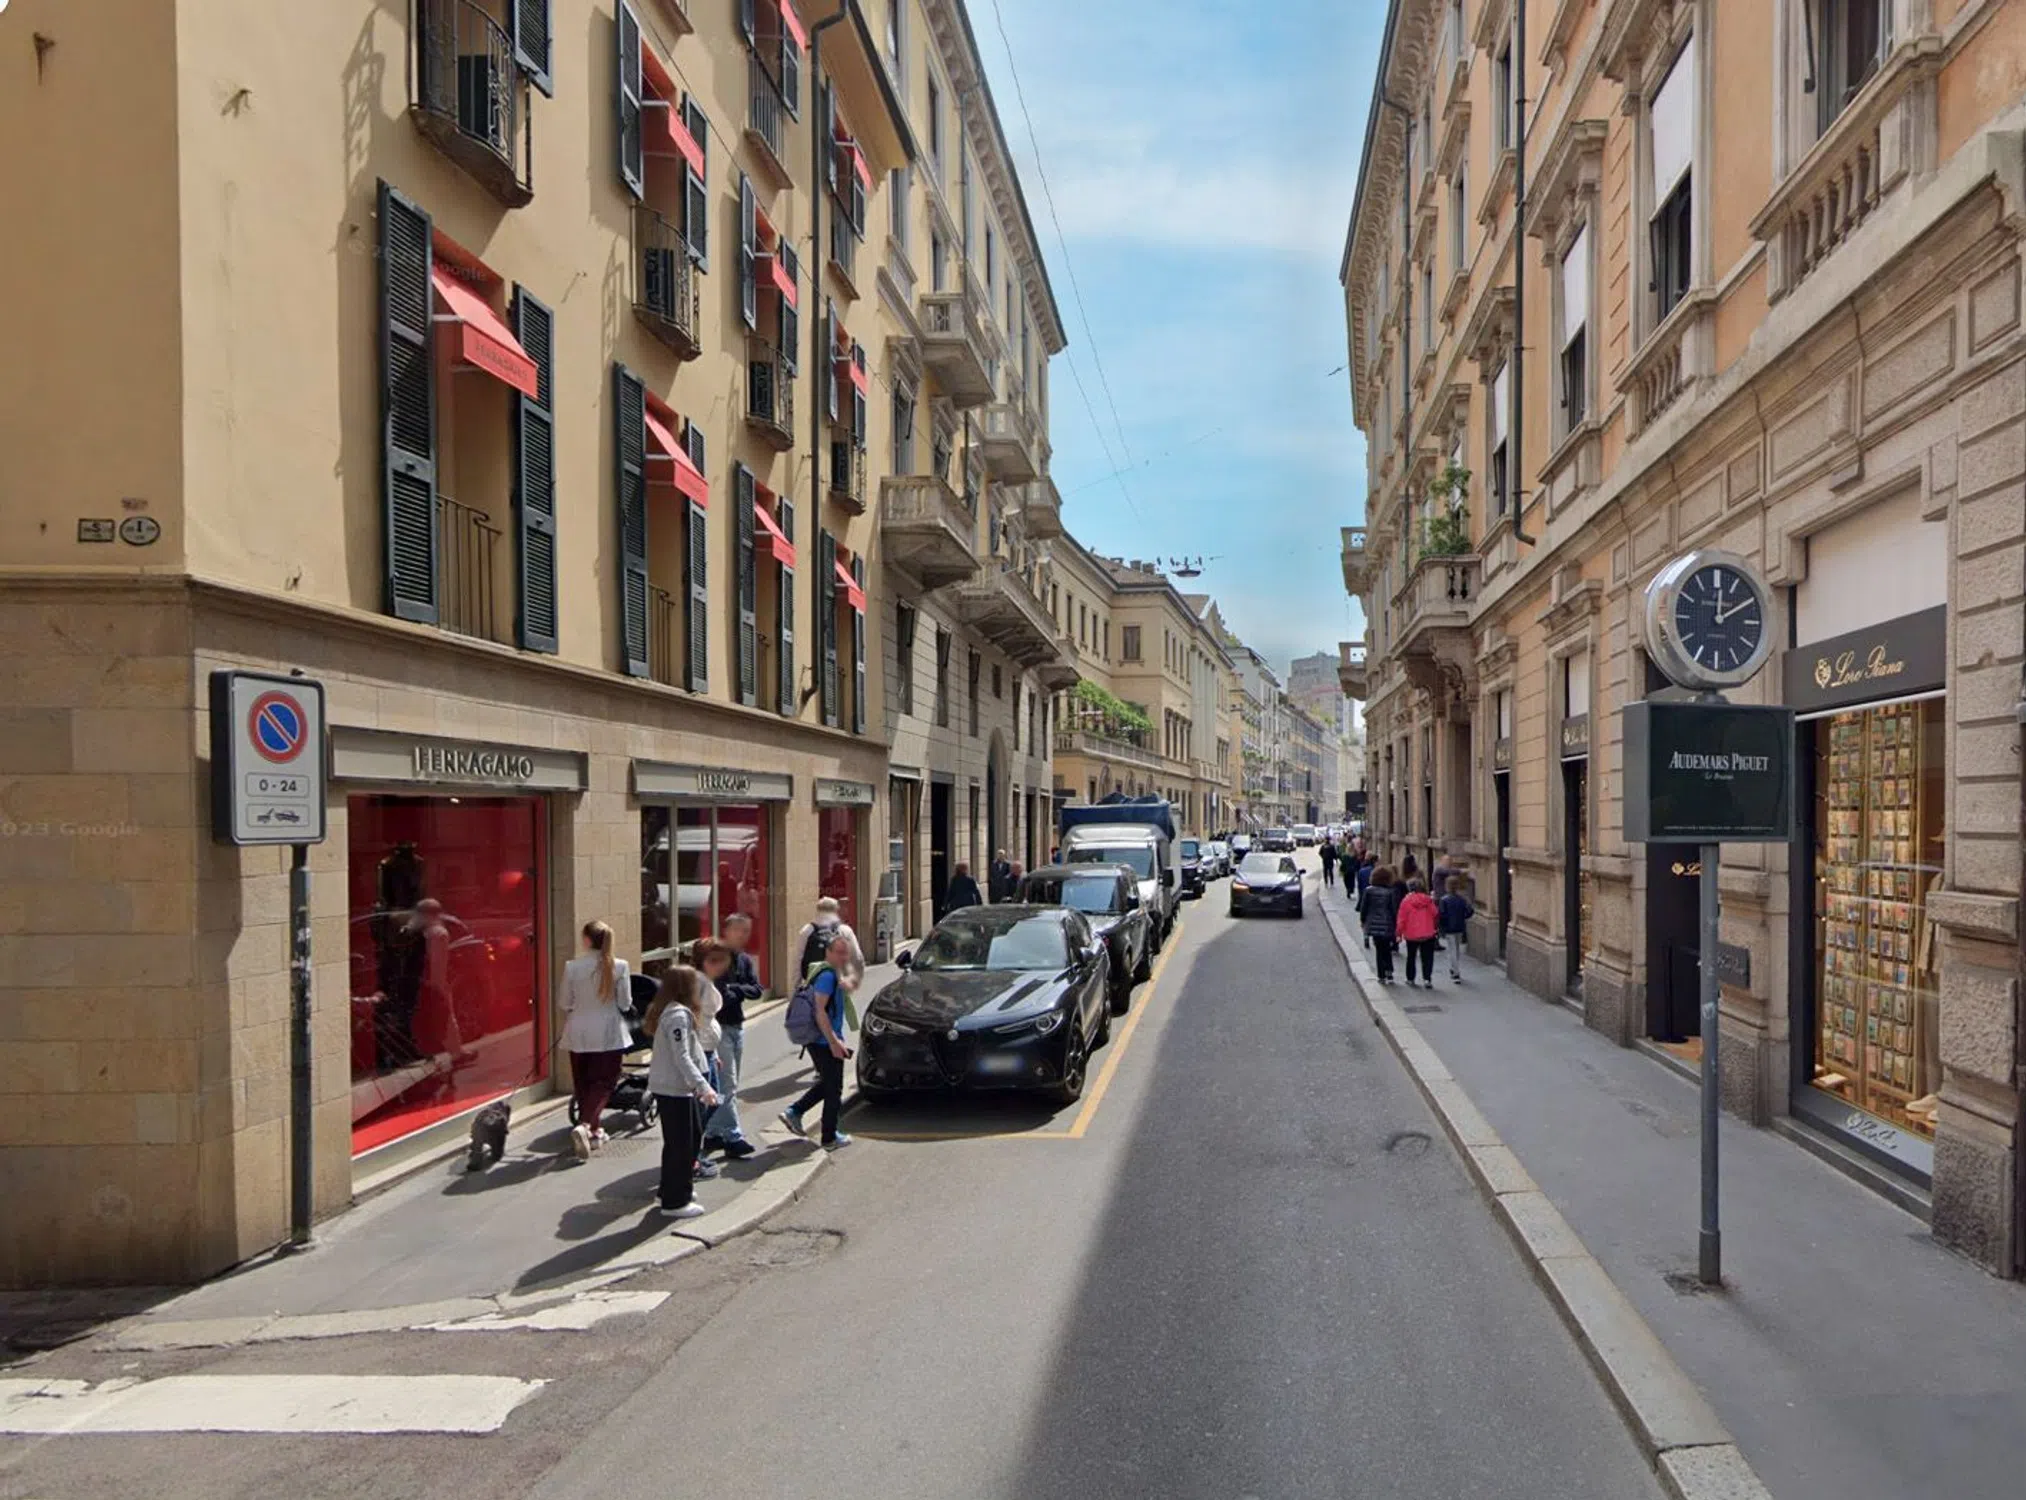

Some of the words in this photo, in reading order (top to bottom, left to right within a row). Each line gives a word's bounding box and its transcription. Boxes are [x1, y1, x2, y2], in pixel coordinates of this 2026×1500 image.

[1864, 643, 1905, 679] Piana
[413, 746, 534, 779] FERRAGAMO
[1668, 751, 1729, 770] AUDEMARS
[1731, 752, 1769, 771] PIGUET
[280, 779, 297, 792] 24
